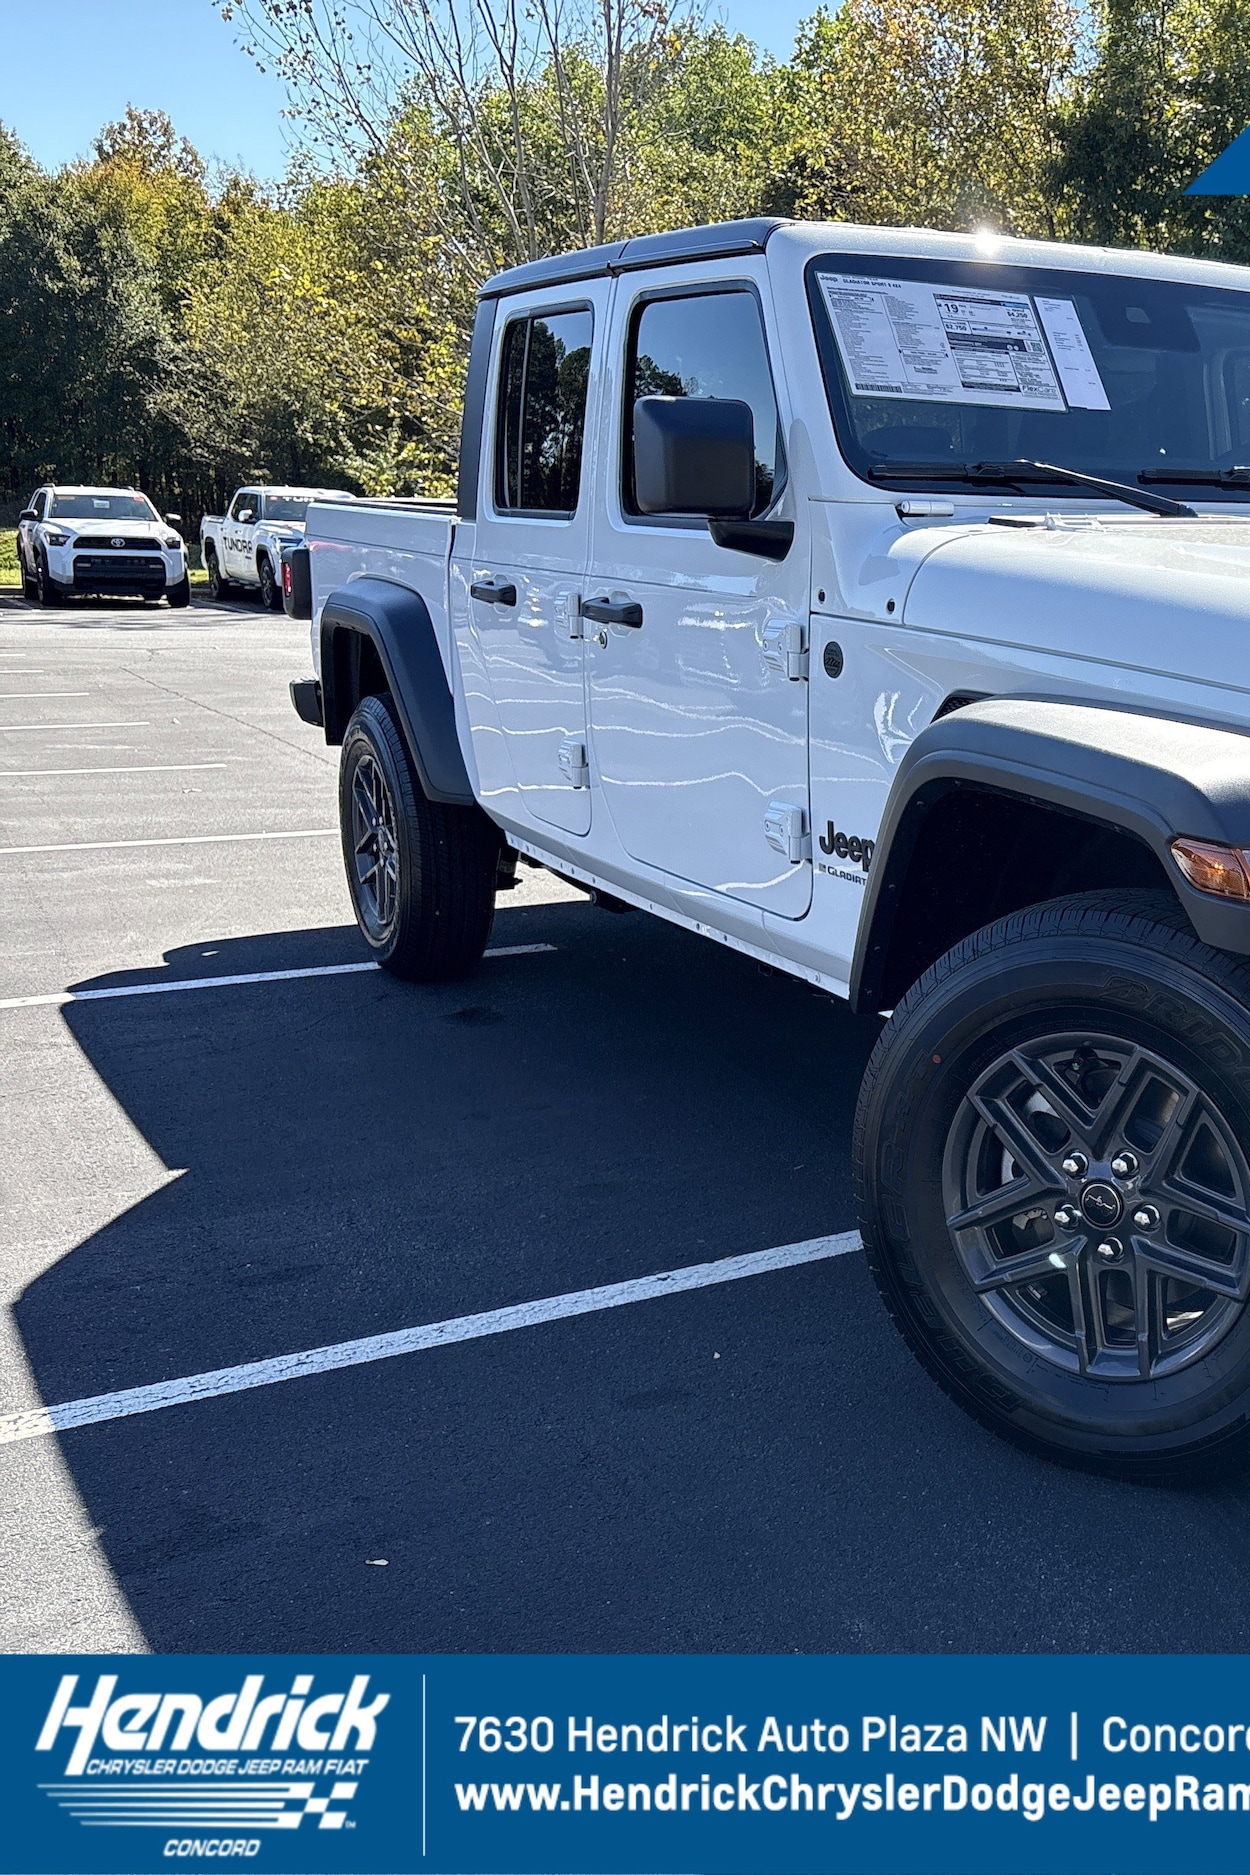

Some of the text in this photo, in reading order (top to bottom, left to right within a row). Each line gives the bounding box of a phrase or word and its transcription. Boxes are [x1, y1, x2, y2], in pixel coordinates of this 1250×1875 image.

[944, 303, 959, 313] 19
[1022, 385, 1056, 393] FlexCare
[223, 536, 253, 554] TUNDRA
[819, 820, 876, 872] Jeep
